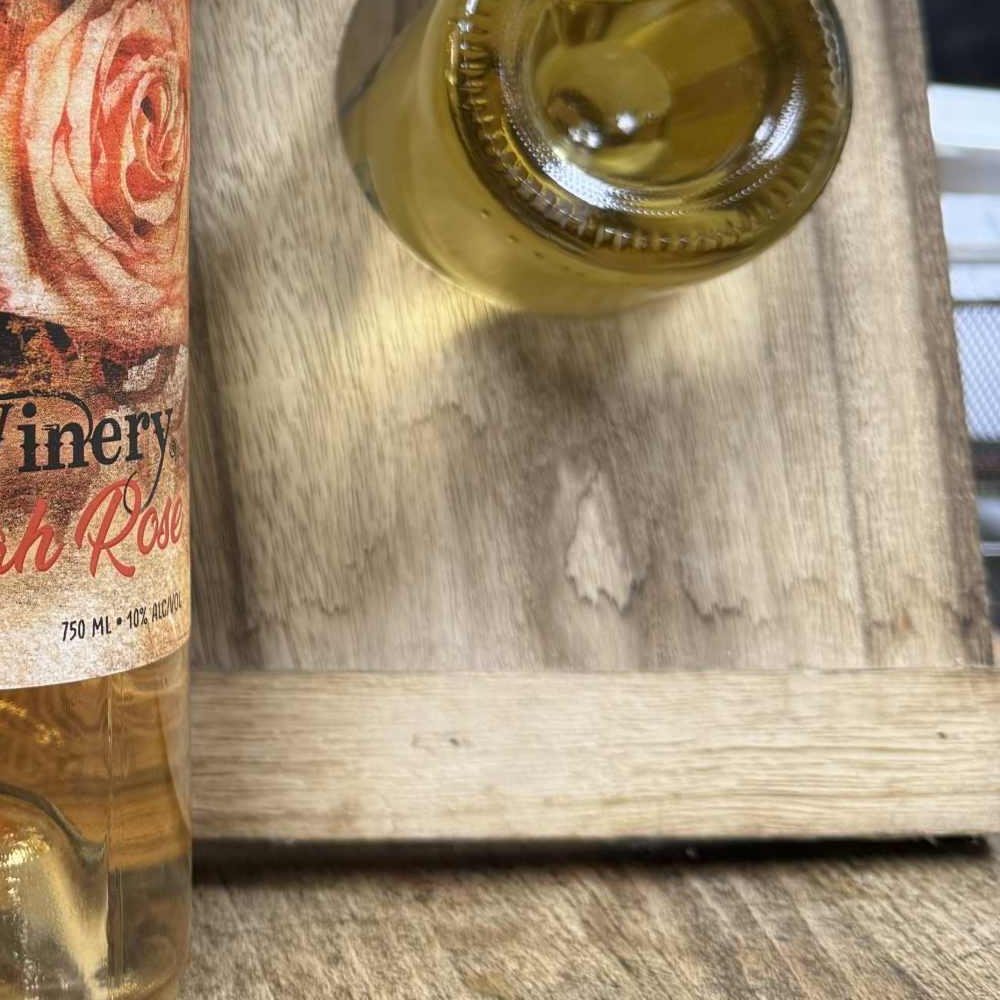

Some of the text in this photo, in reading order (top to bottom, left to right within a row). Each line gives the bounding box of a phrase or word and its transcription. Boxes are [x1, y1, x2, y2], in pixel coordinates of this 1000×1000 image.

[61, 591, 182, 642] 750 ML 10% ALC/VOL
